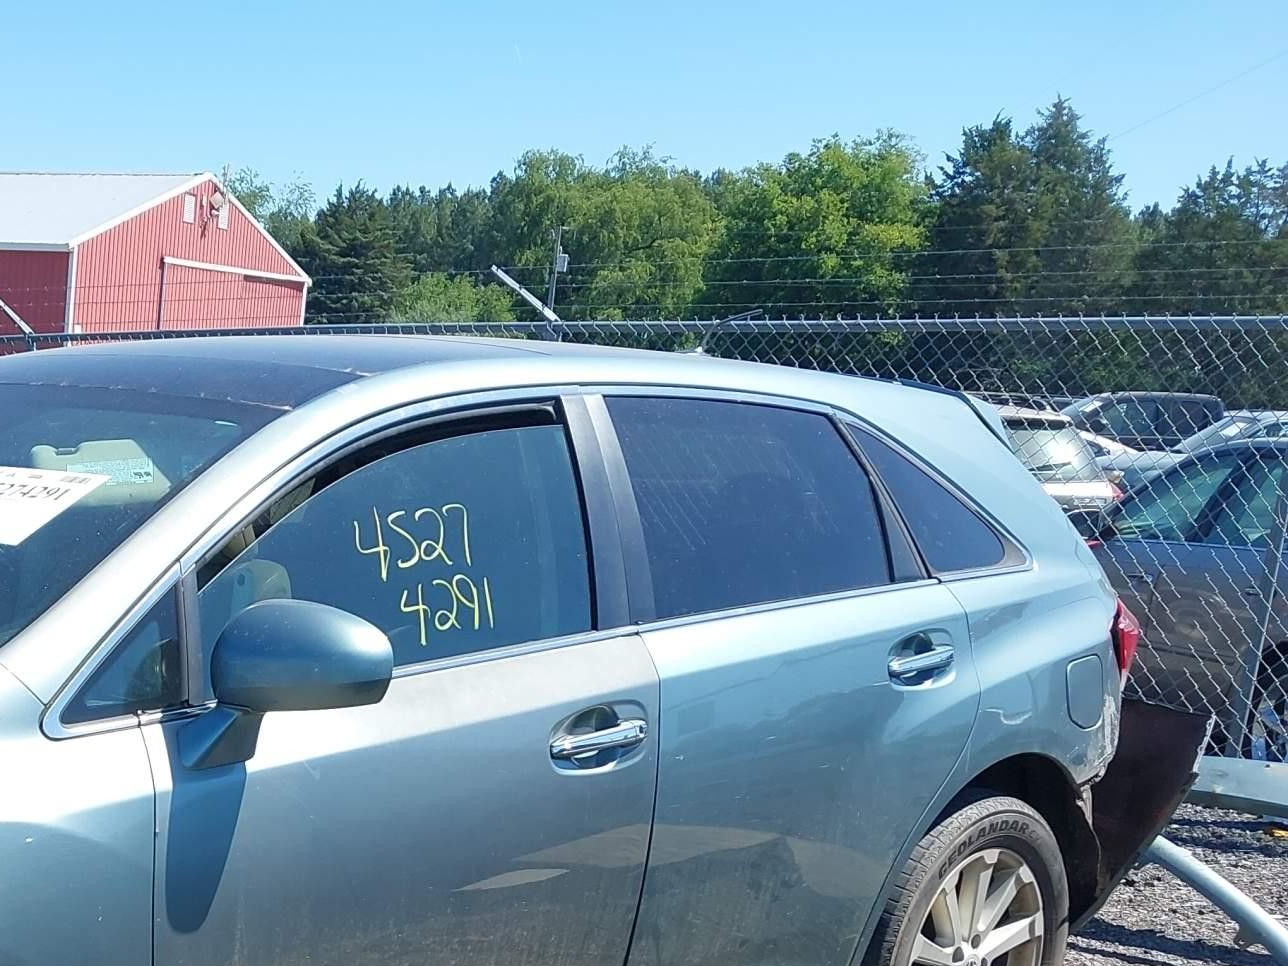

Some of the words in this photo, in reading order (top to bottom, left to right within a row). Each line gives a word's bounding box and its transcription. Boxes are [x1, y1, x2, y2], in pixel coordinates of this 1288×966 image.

[353, 503, 472, 583] 4527
[400, 573, 494, 647] 4291
[938, 819, 1029, 880] GEOLANDAR
